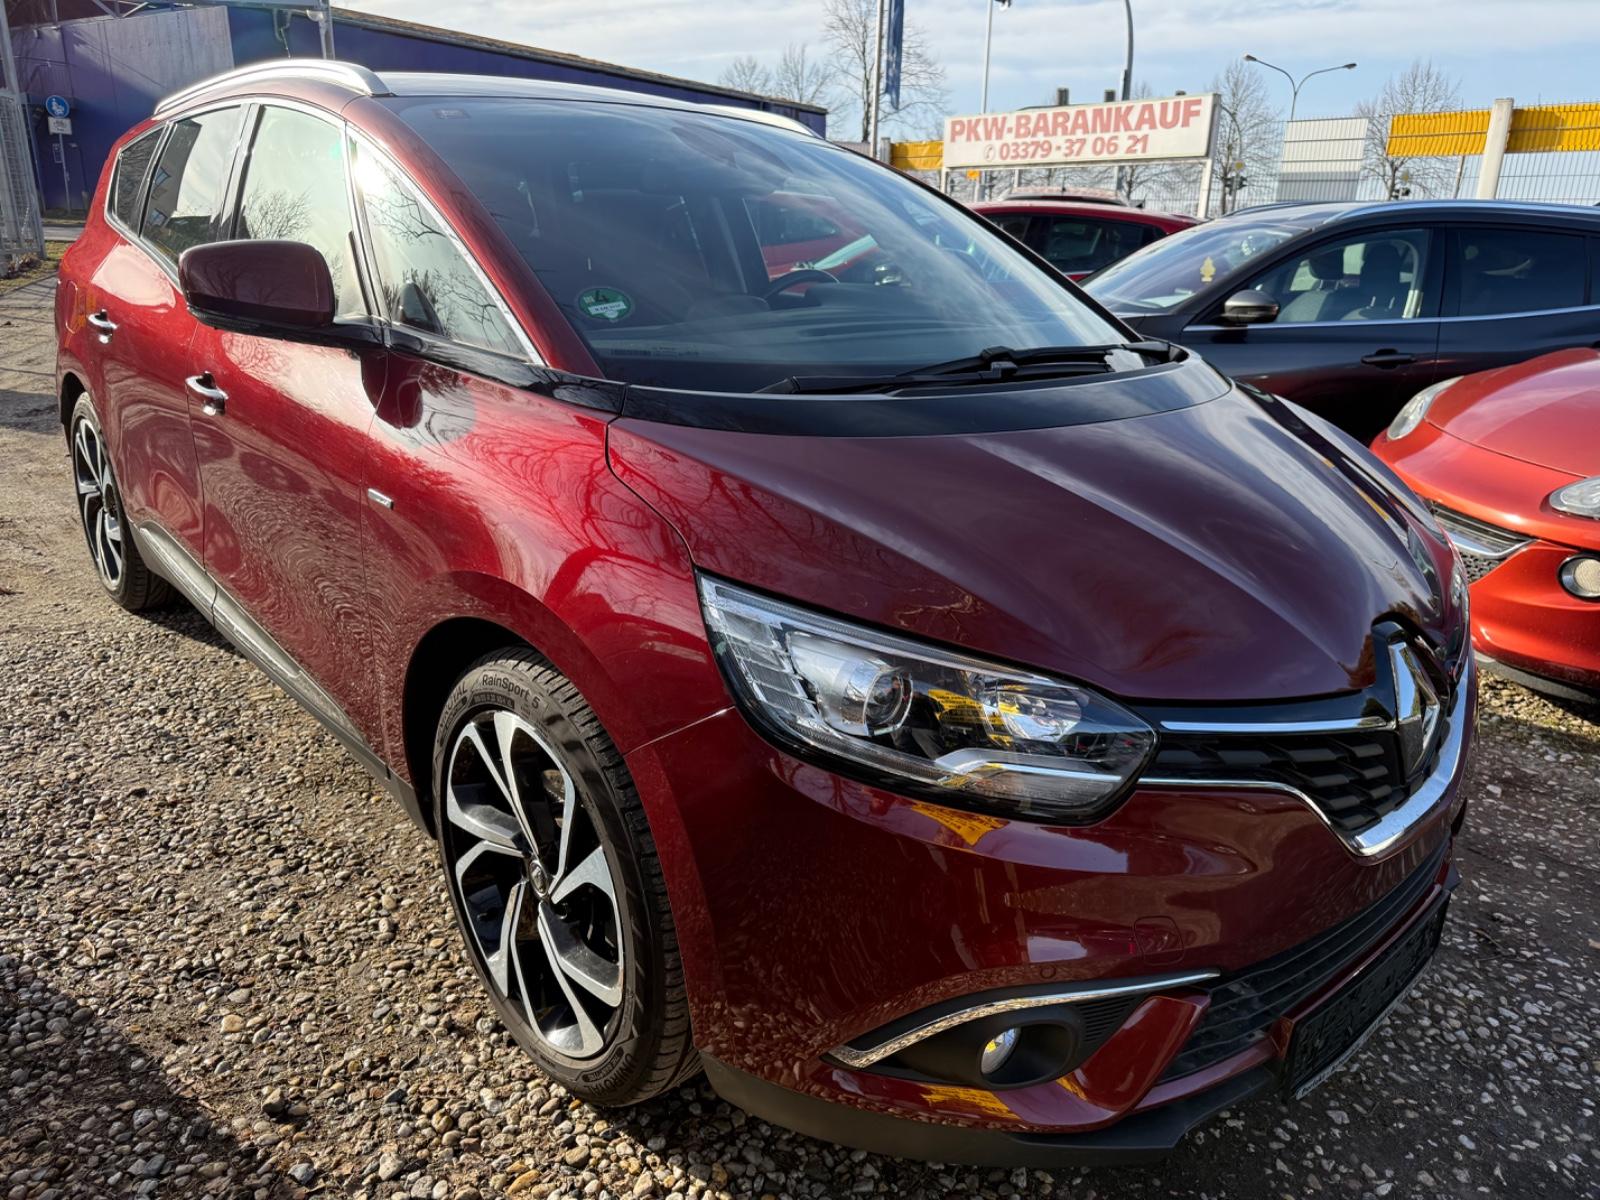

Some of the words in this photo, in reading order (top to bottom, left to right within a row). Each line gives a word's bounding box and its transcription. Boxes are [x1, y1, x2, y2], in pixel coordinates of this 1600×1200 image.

[950, 98, 1202, 143] PKW-BARANKAUF
[999, 140, 1052, 161] 03379
[1092, 136, 1119, 155] 06
[1126, 134, 1149, 154] 21
[482, 673, 531, 700] RainSport
[531, 696, 541, 709] 5
